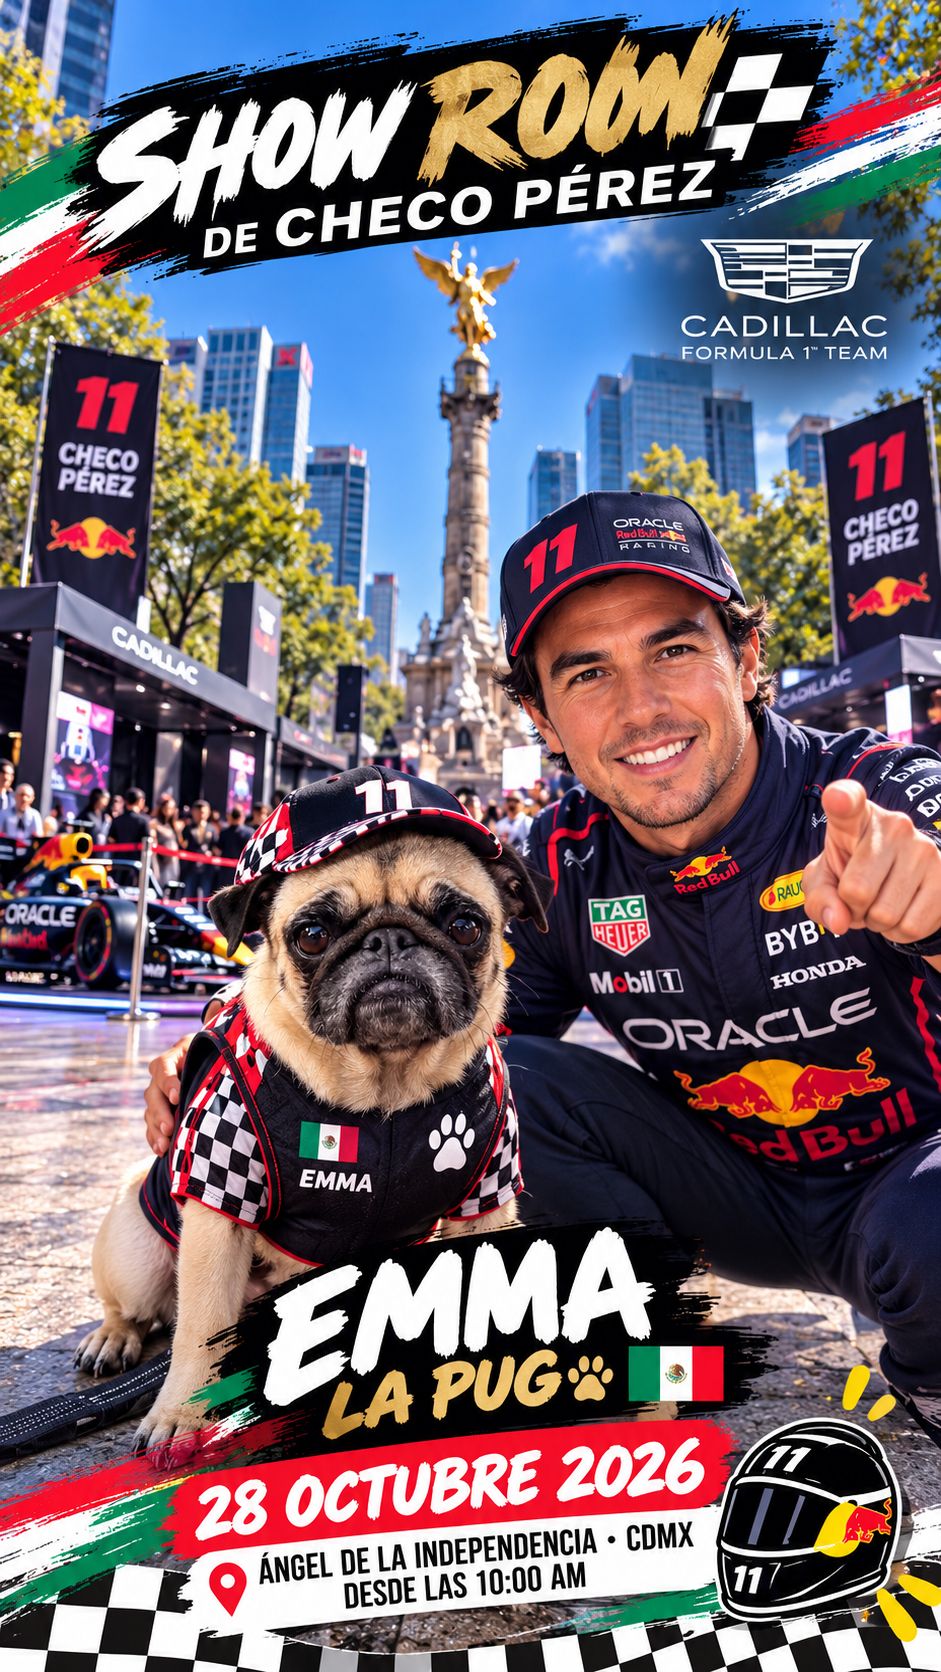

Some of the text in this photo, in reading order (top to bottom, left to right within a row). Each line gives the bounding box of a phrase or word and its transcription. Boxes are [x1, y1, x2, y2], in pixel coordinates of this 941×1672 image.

[75, 375, 140, 435] 11
[58, 441, 140, 472] CHECO
[848, 430, 906, 501] 11
[57, 464, 137, 498] PÉREZ
[613, 518, 684, 532] ORACLE
[843, 498, 919, 542] CHECO
[523, 523, 578, 594] 11
[847, 523, 919, 566] PÉREZ
[111, 625, 199, 686] CADILLAC
[778, 667, 852, 709] CADILLAC
[354, 779, 415, 815] 11
[777, 882, 803, 901] RAU
[5, 903, 77, 928] ORACLE
[593, 899, 643, 921] TAG
[594, 922, 648, 952] HEUER
[764, 919, 840, 957] BYB
[589, 969, 656, 994] Mobil
[770, 955, 867, 990] HONDA
[623, 987, 878, 1051] ORACLE
[709, 1118, 799, 1163] ed
[800, 1087, 917, 1161] Bull
[299, 1168, 373, 1193] EMMA
